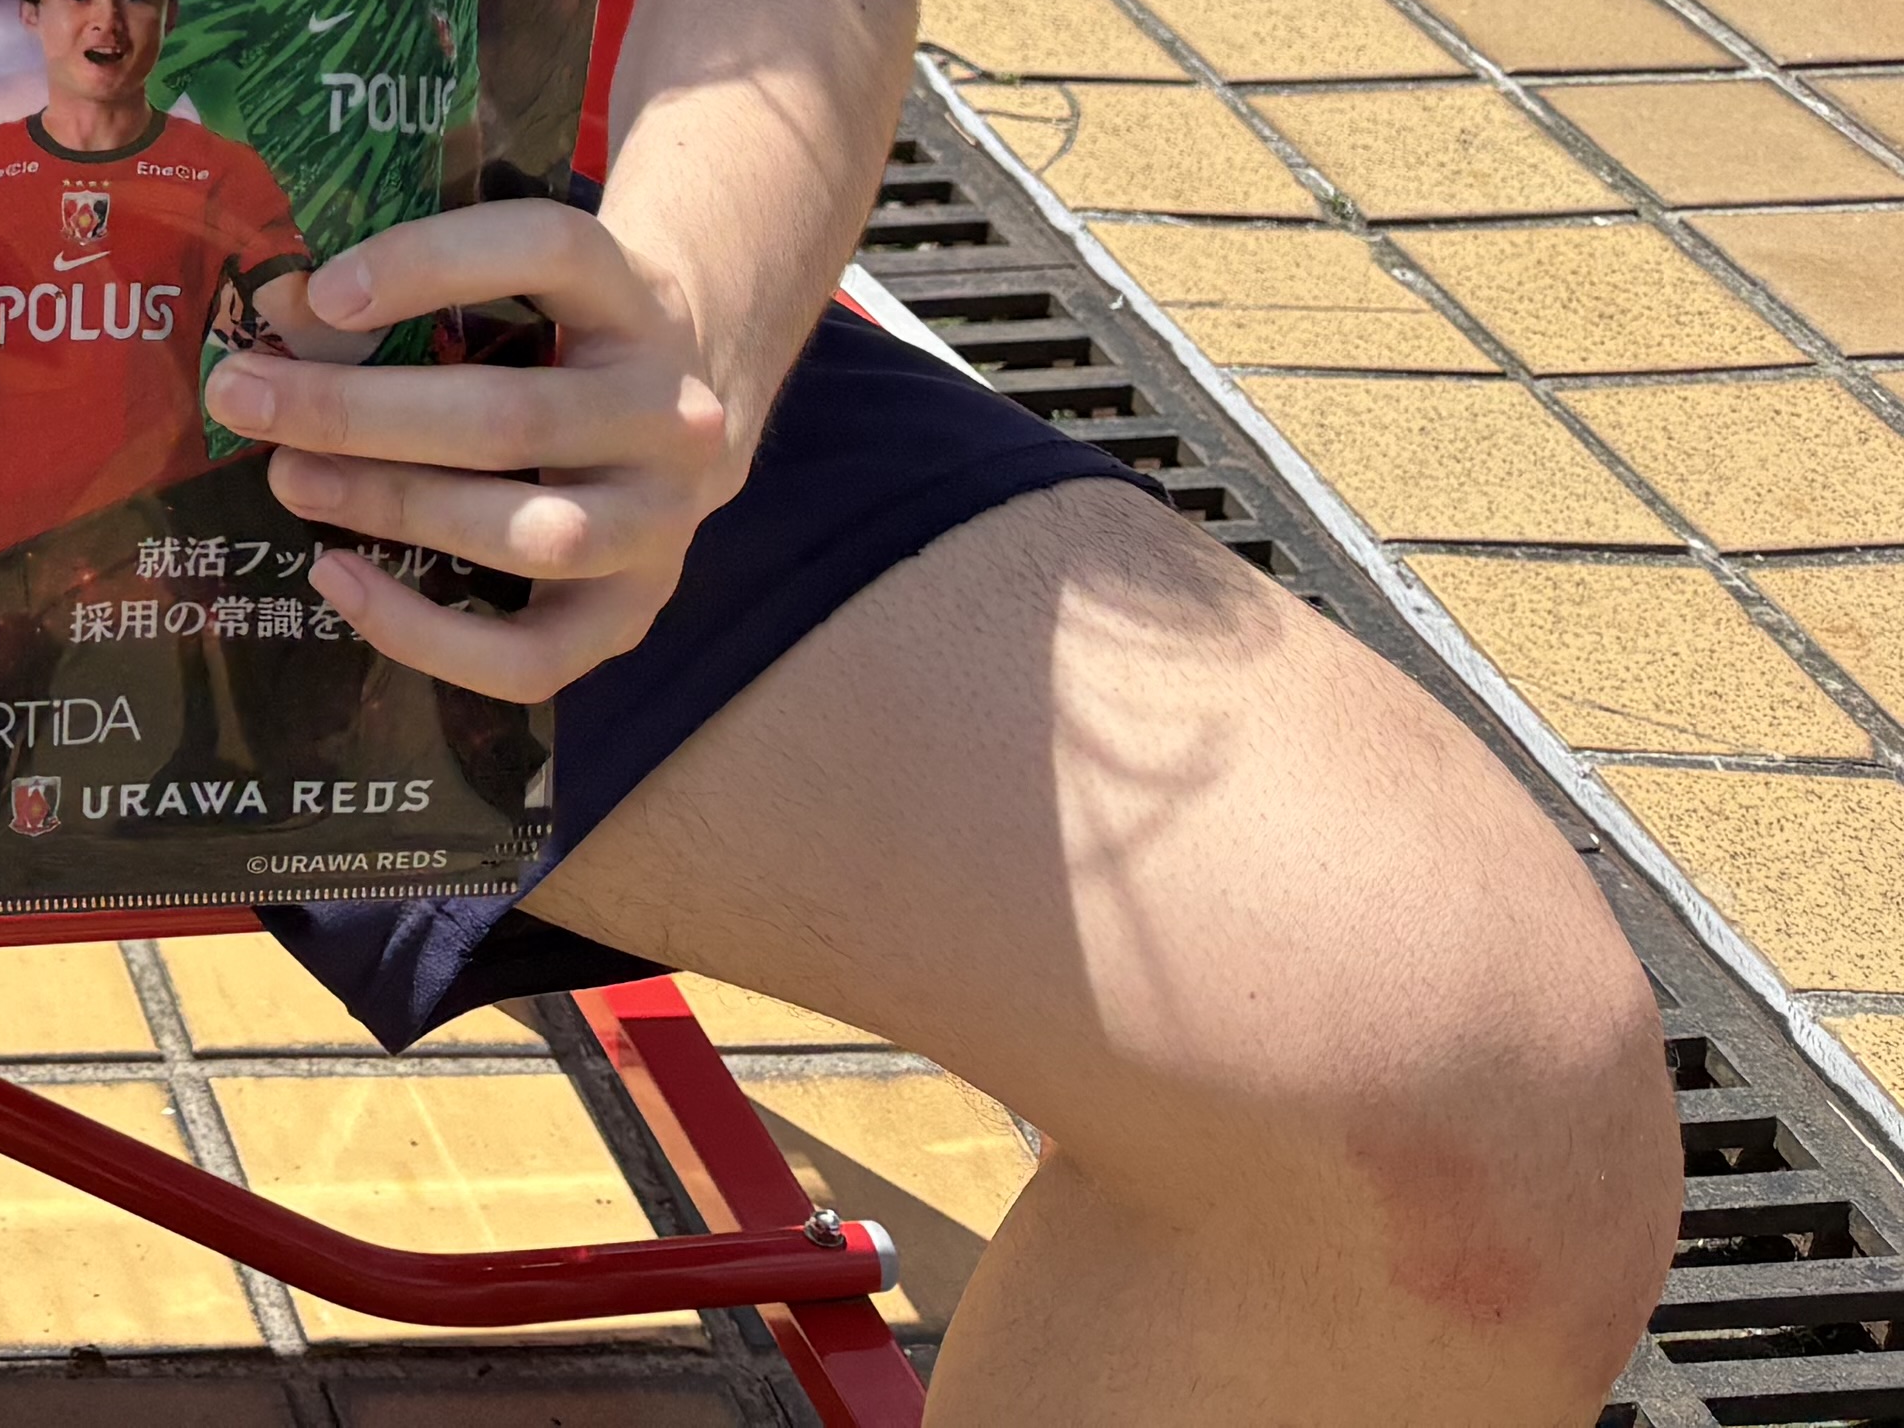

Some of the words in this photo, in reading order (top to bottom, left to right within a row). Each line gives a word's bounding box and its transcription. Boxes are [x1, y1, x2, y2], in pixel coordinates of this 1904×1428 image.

[81, 780, 269, 820] URAWA
[293, 779, 434, 814] REDS
[376, 849, 449, 871] REDS
